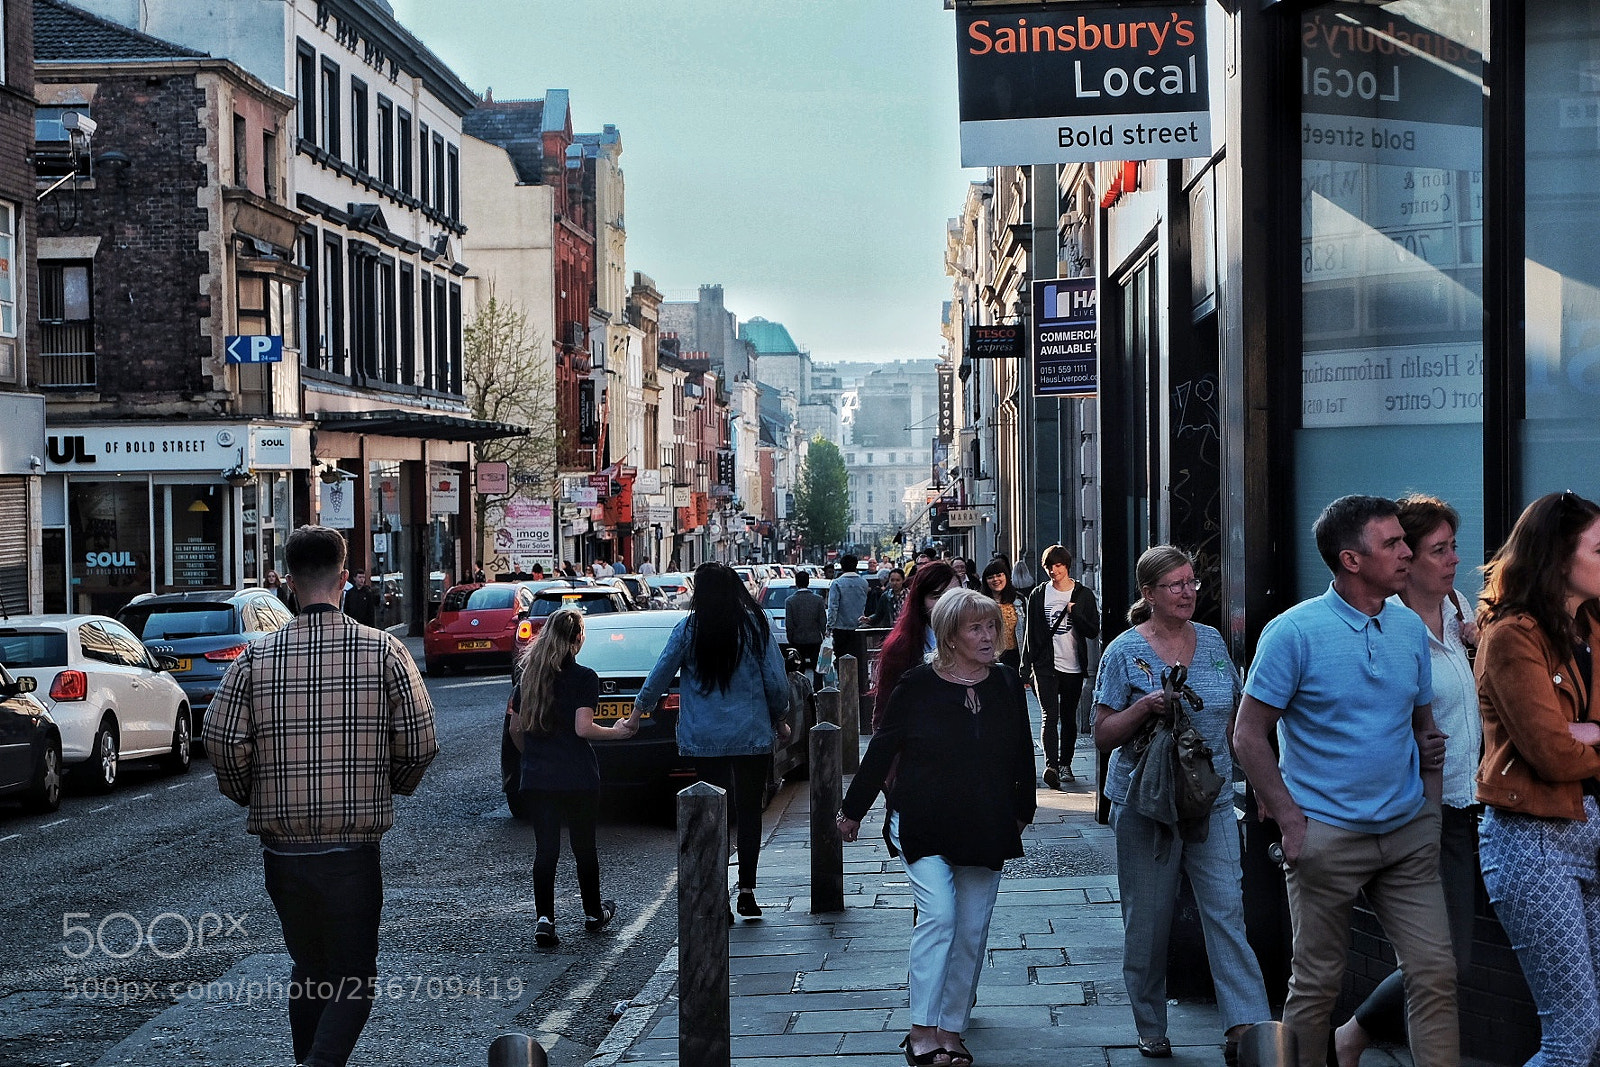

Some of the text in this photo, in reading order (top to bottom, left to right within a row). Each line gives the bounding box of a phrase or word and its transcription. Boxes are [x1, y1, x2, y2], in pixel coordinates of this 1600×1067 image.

[968, 12, 1195, 56] Sainsbury's
[1074, 54, 1197, 98] Local
[1058, 121, 1199, 147] Bold street
[1073, 309, 1094, 317] LIVE
[976, 329, 1016, 338] TESCO
[251, 336, 272, 361] P
[977, 344, 1014, 353] express
[1040, 343, 1092, 355] AVAILABLE
[1040, 364, 1087, 374] 0151 559 1111
[261, 439, 285, 447] SOUL
[46, 436, 205, 464] UL OF BOLD STREET
[950, 513, 979, 521] MARAY
[516, 529, 550, 540] image
[85, 551, 136, 568] SOUL
